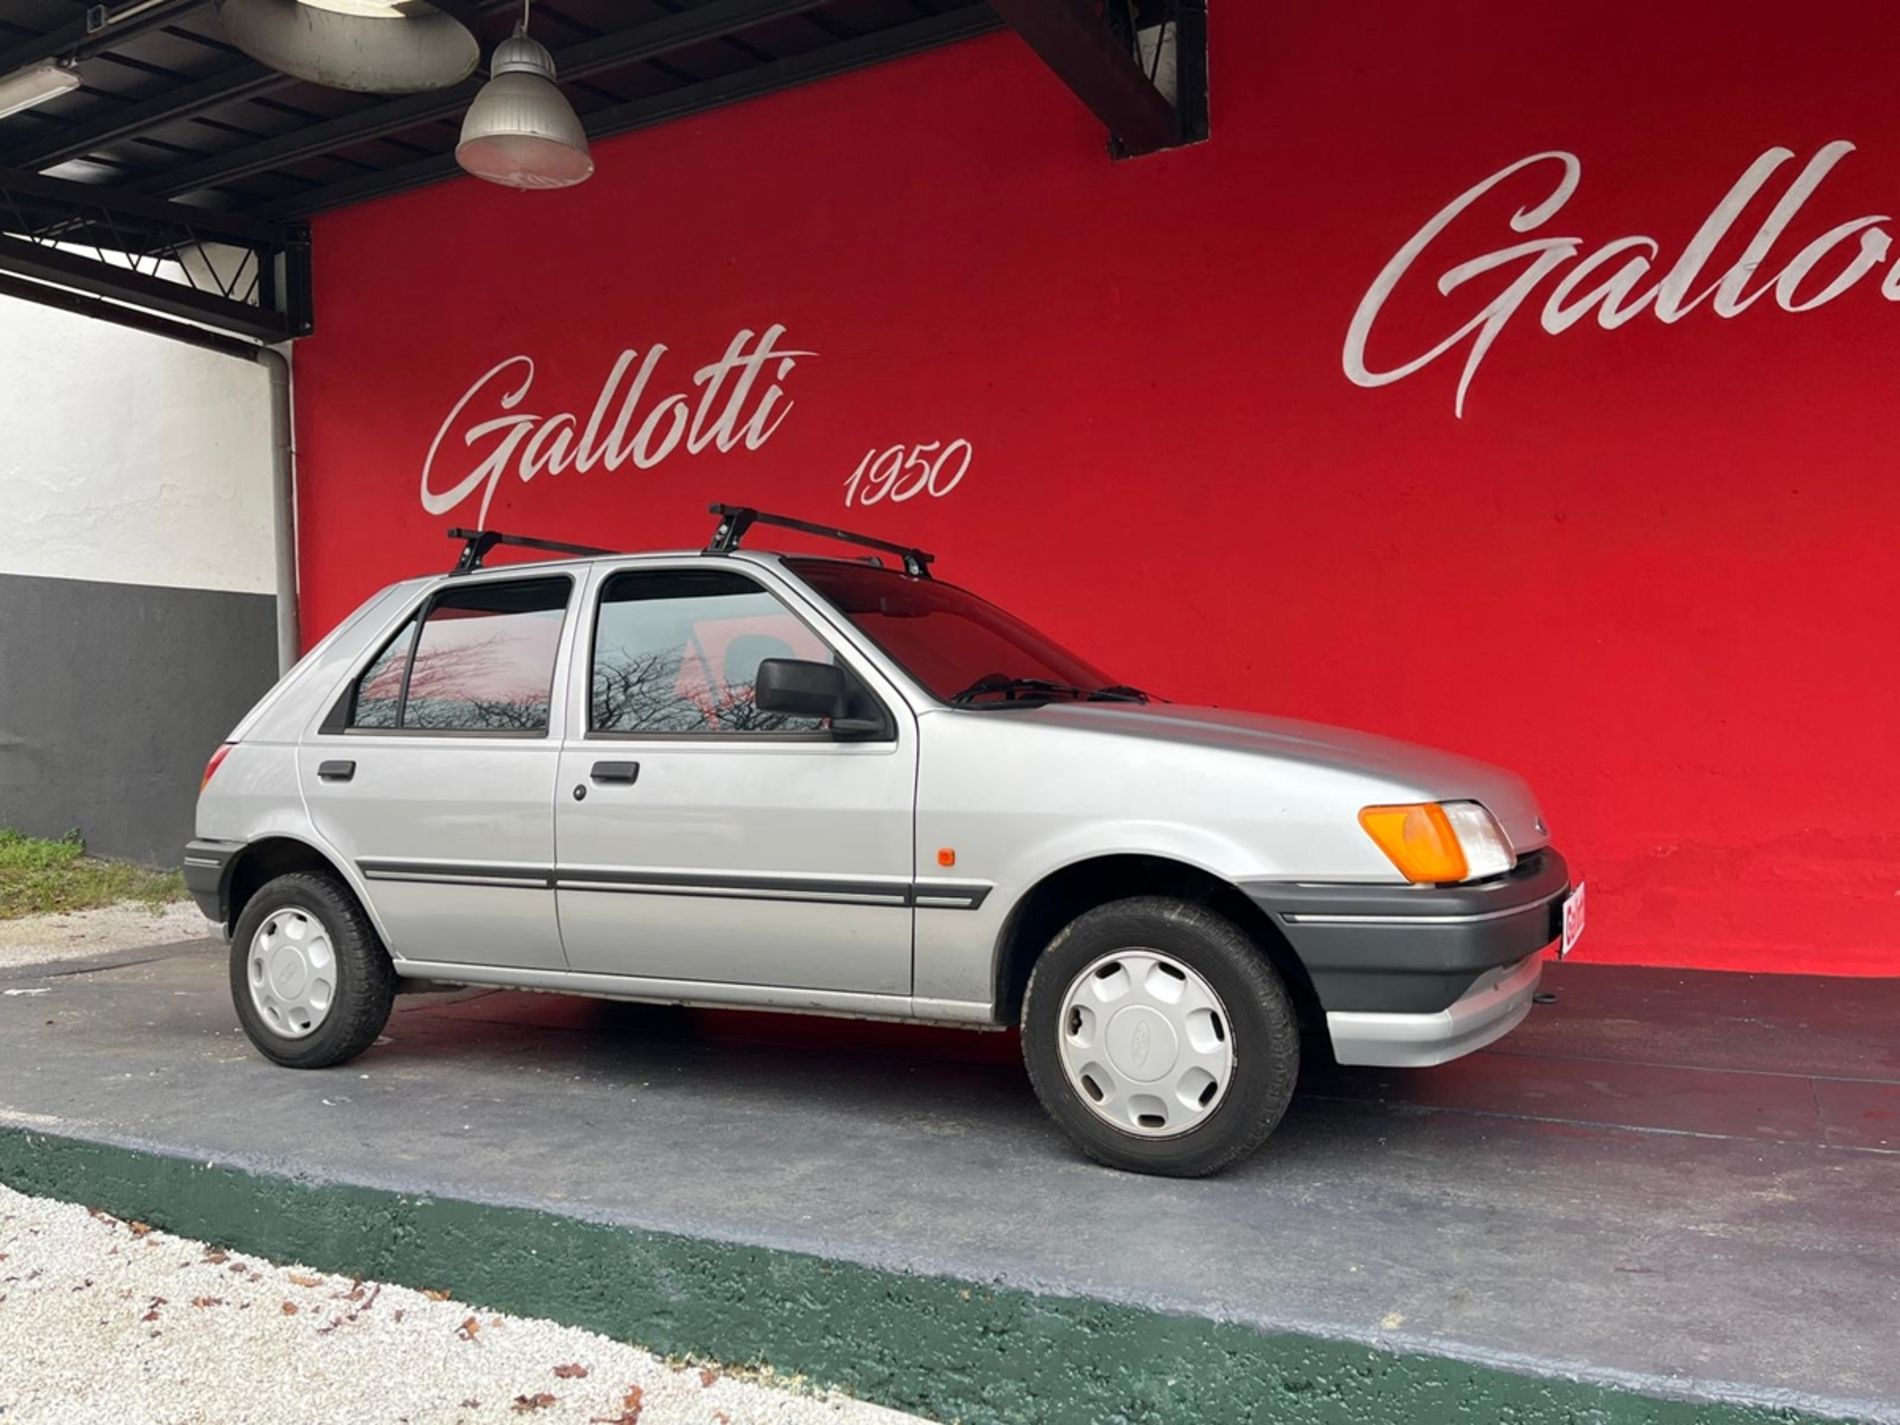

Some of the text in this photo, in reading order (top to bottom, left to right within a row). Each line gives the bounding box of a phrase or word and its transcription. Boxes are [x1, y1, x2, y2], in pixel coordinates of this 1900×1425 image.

[1343, 140, 1900, 419] Gallo
[420, 324, 819, 531] Gallotti
[844, 438, 972, 507] 1950
